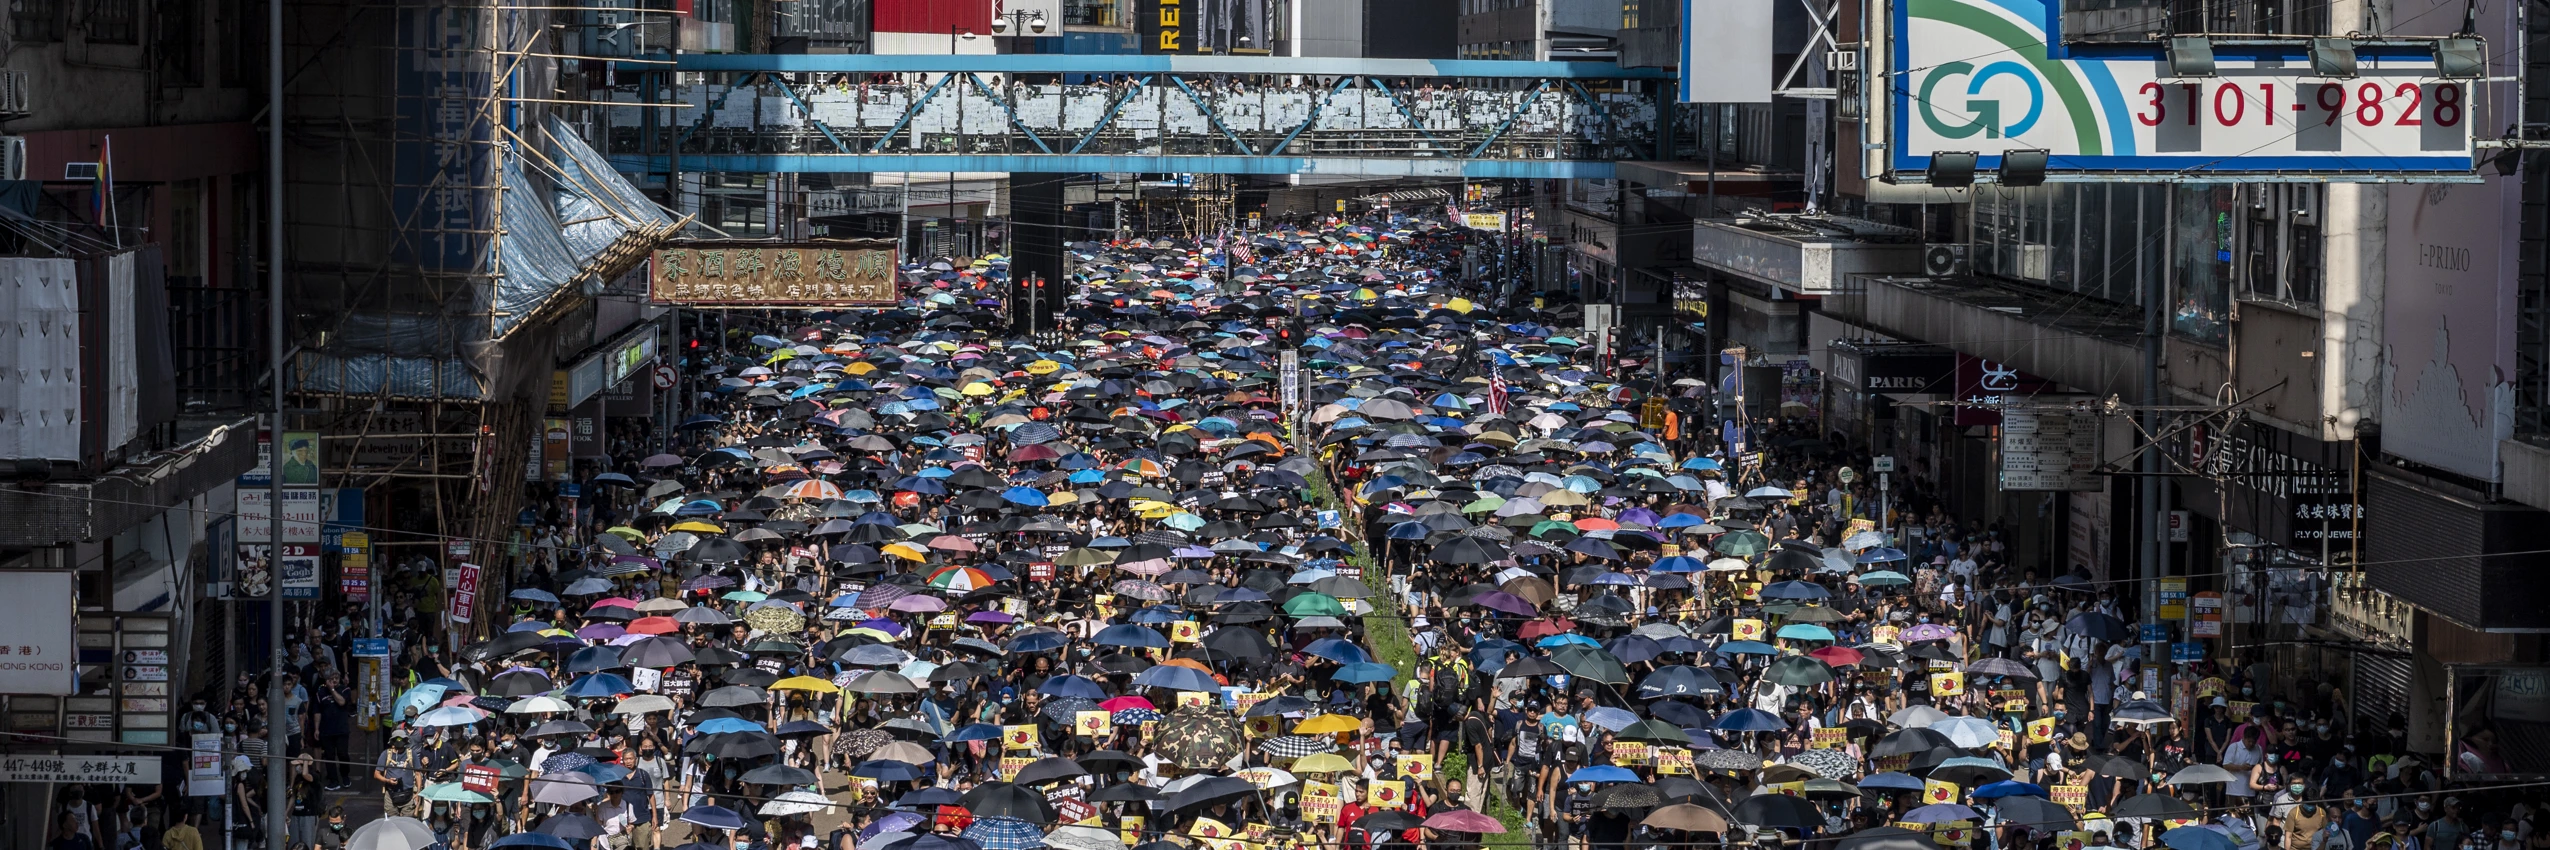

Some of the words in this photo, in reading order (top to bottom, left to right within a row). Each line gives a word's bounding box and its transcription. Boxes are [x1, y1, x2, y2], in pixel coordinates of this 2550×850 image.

[1160, 0, 1180, 50] RE
[2137, 82, 2461, 127] 3101-9828
[2419, 244, 2470, 271] I-PRIMO
[2435, 283, 2452, 296] TOKYO
[1833, 353, 1856, 384] PARIS
[1869, 376, 1925, 389] PARIS
[576, 418, 592, 434] 福
[367, 443, 398, 454] Jewelry
[2295, 530, 2310, 539] FLY
[282, 588, 312, 597] 高廚房
[455, 567, 475, 618] 小心車頂
[29, 662, 64, 672] KONG)
[3, 760, 65, 773] 447-449號
[81, 761, 138, 775] 合群大廈
